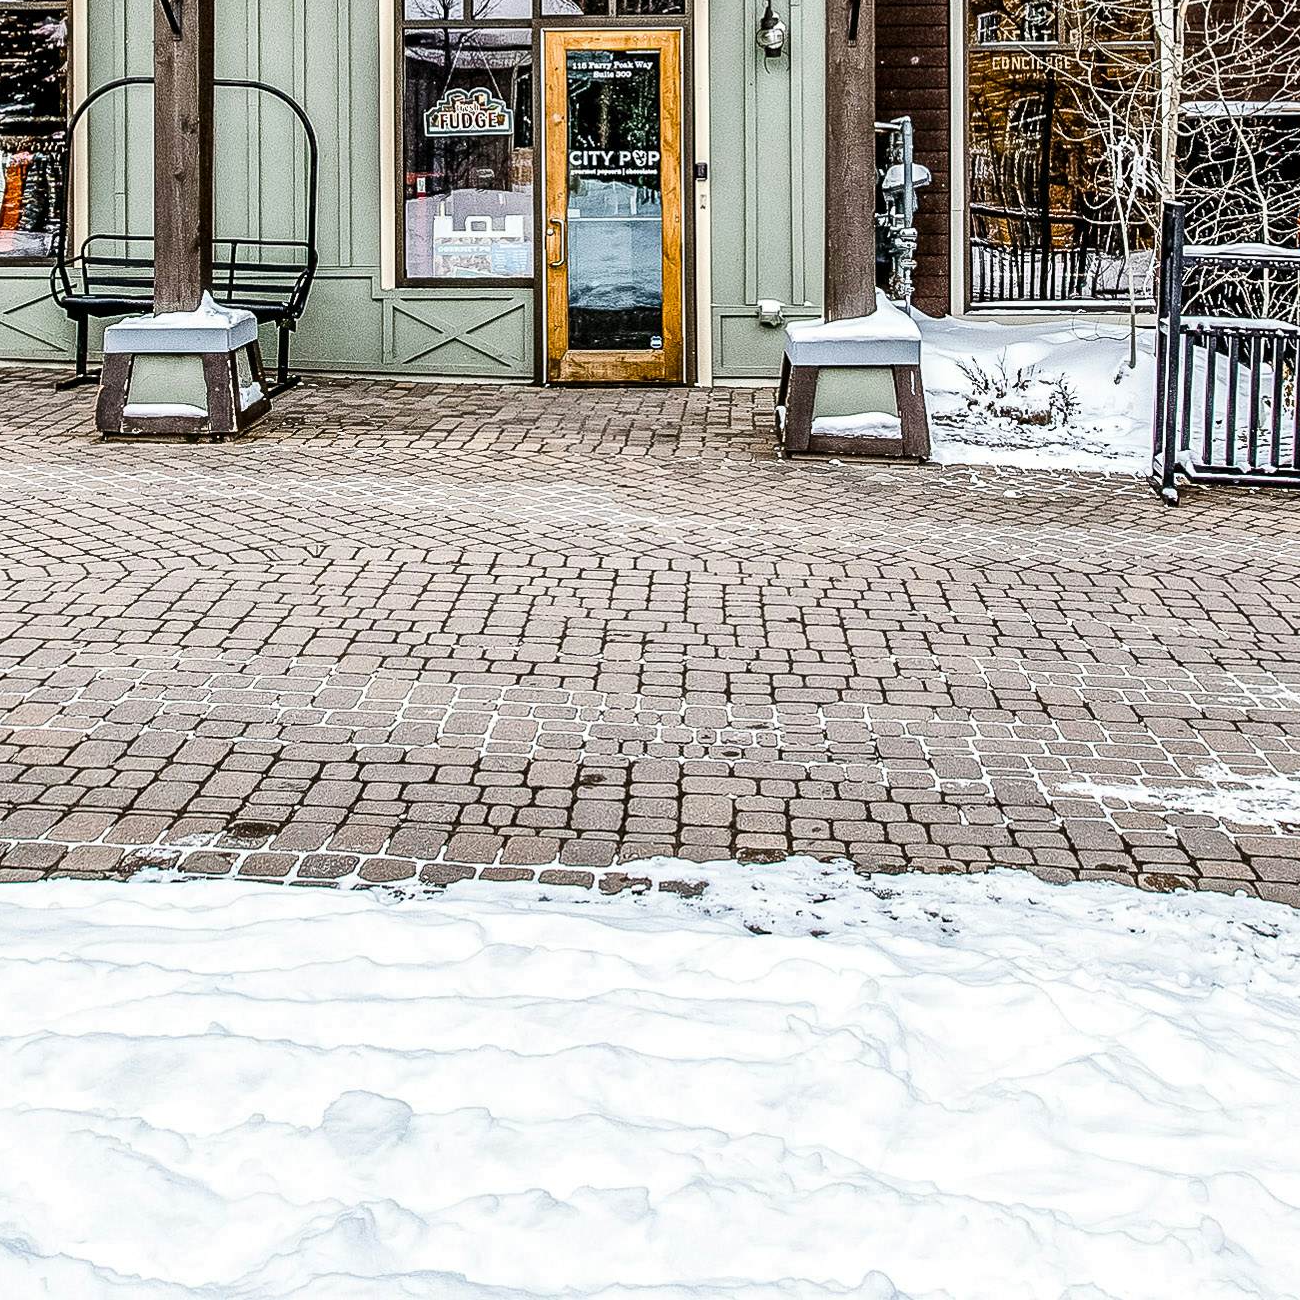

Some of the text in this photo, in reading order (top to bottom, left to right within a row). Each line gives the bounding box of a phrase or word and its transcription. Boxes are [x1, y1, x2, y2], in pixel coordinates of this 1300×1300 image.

[634, 60, 654, 70] Way
[456, 102, 480, 113] fresh
[440, 112, 497, 130] FUDGE
[569, 150, 615, 166] CITY
